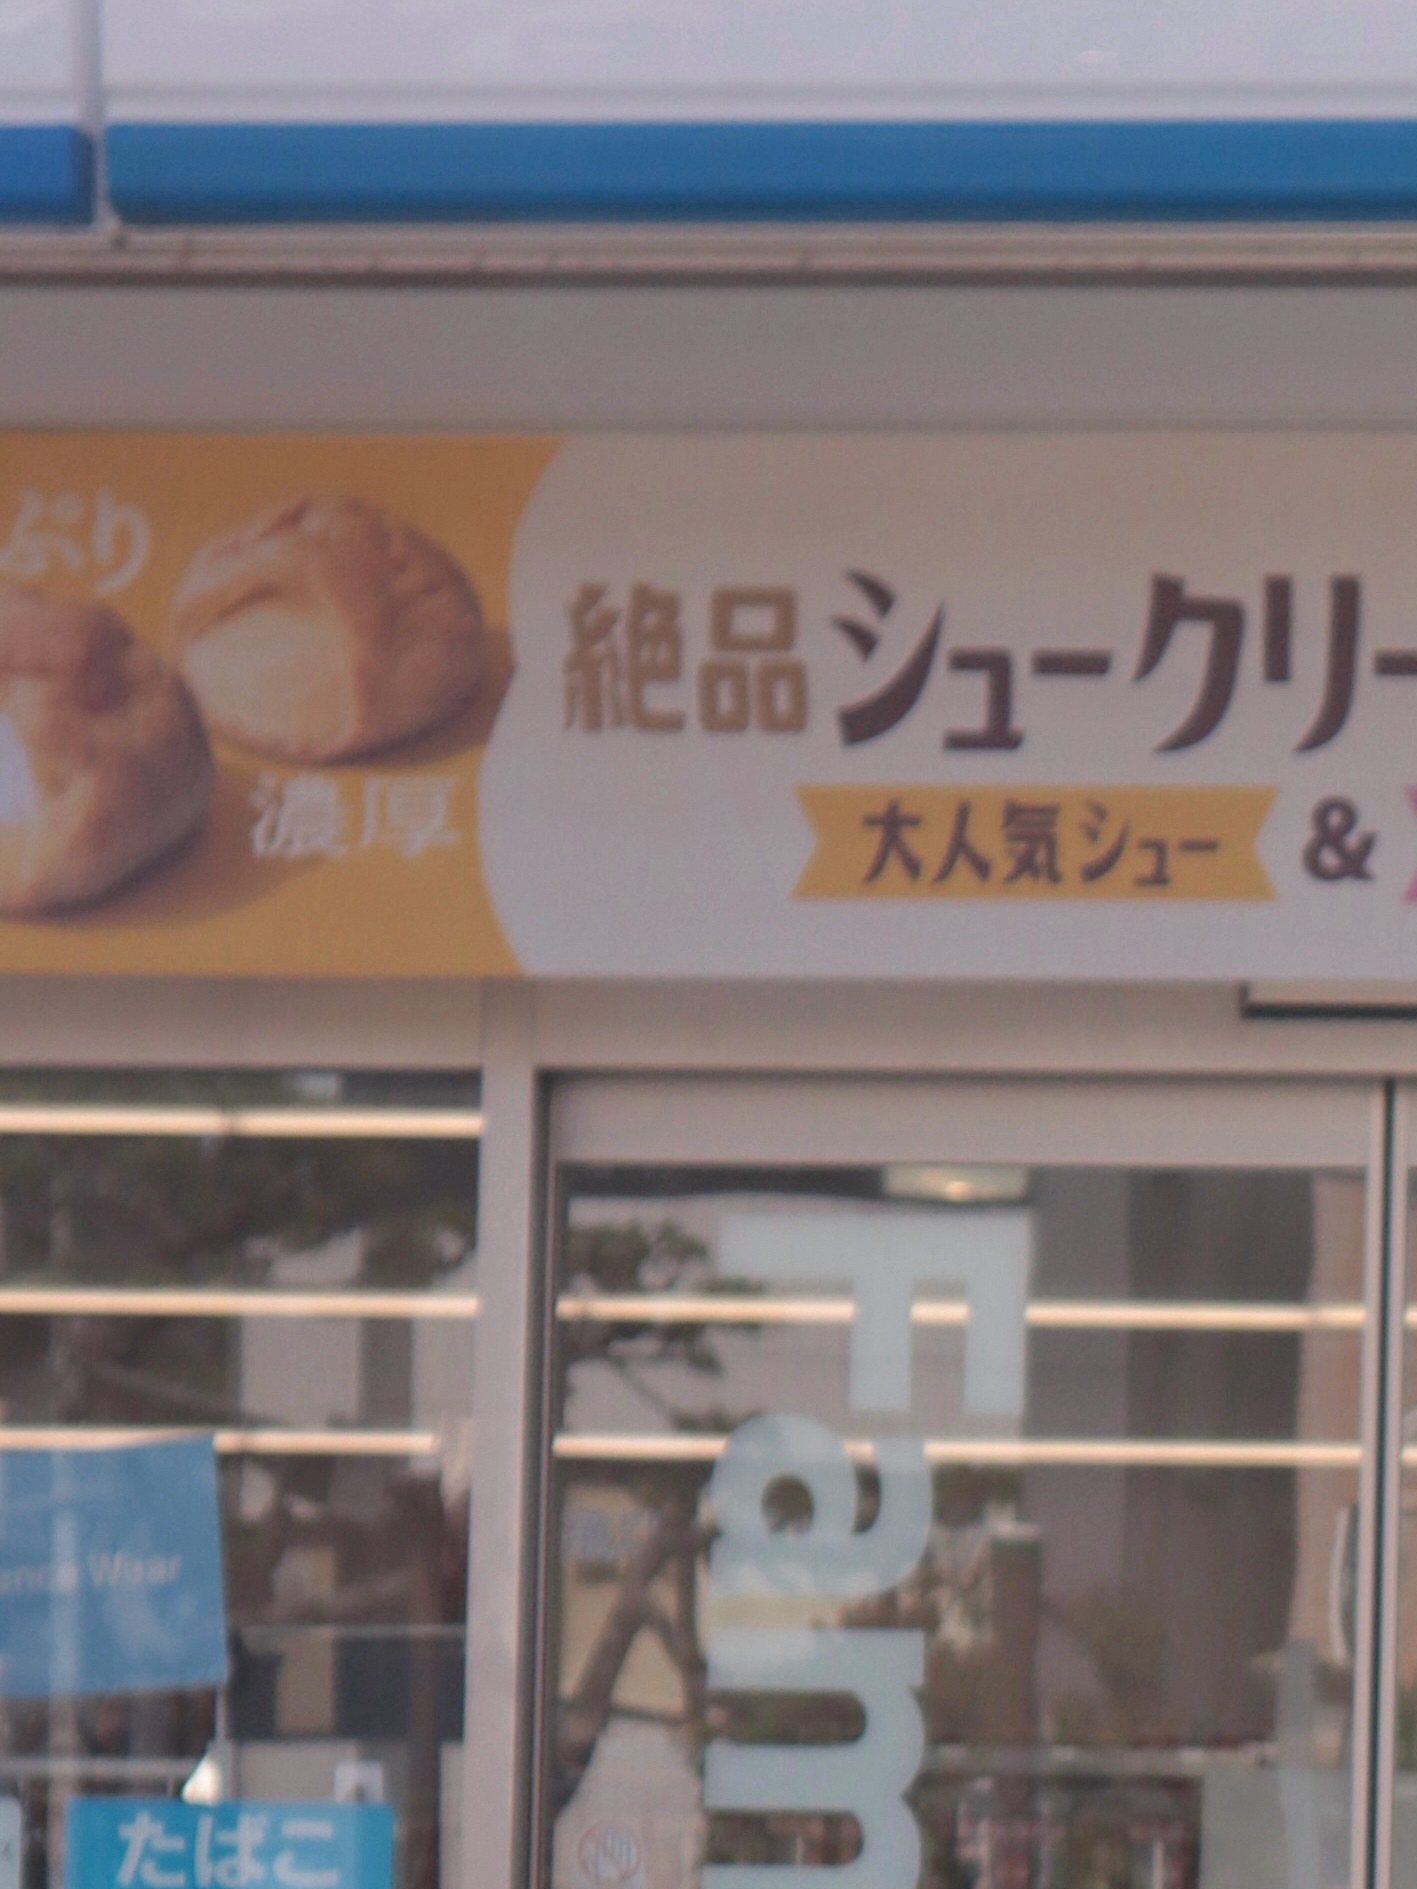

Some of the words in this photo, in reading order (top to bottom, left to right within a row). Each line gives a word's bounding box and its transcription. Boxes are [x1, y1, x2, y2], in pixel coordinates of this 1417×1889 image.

[248, 768, 464, 860] 濃厚
[862, 799, 1222, 890] 大人気シュー
[1302, 797, 1378, 884] &
[116, 1810, 340, 1889] たばこ
